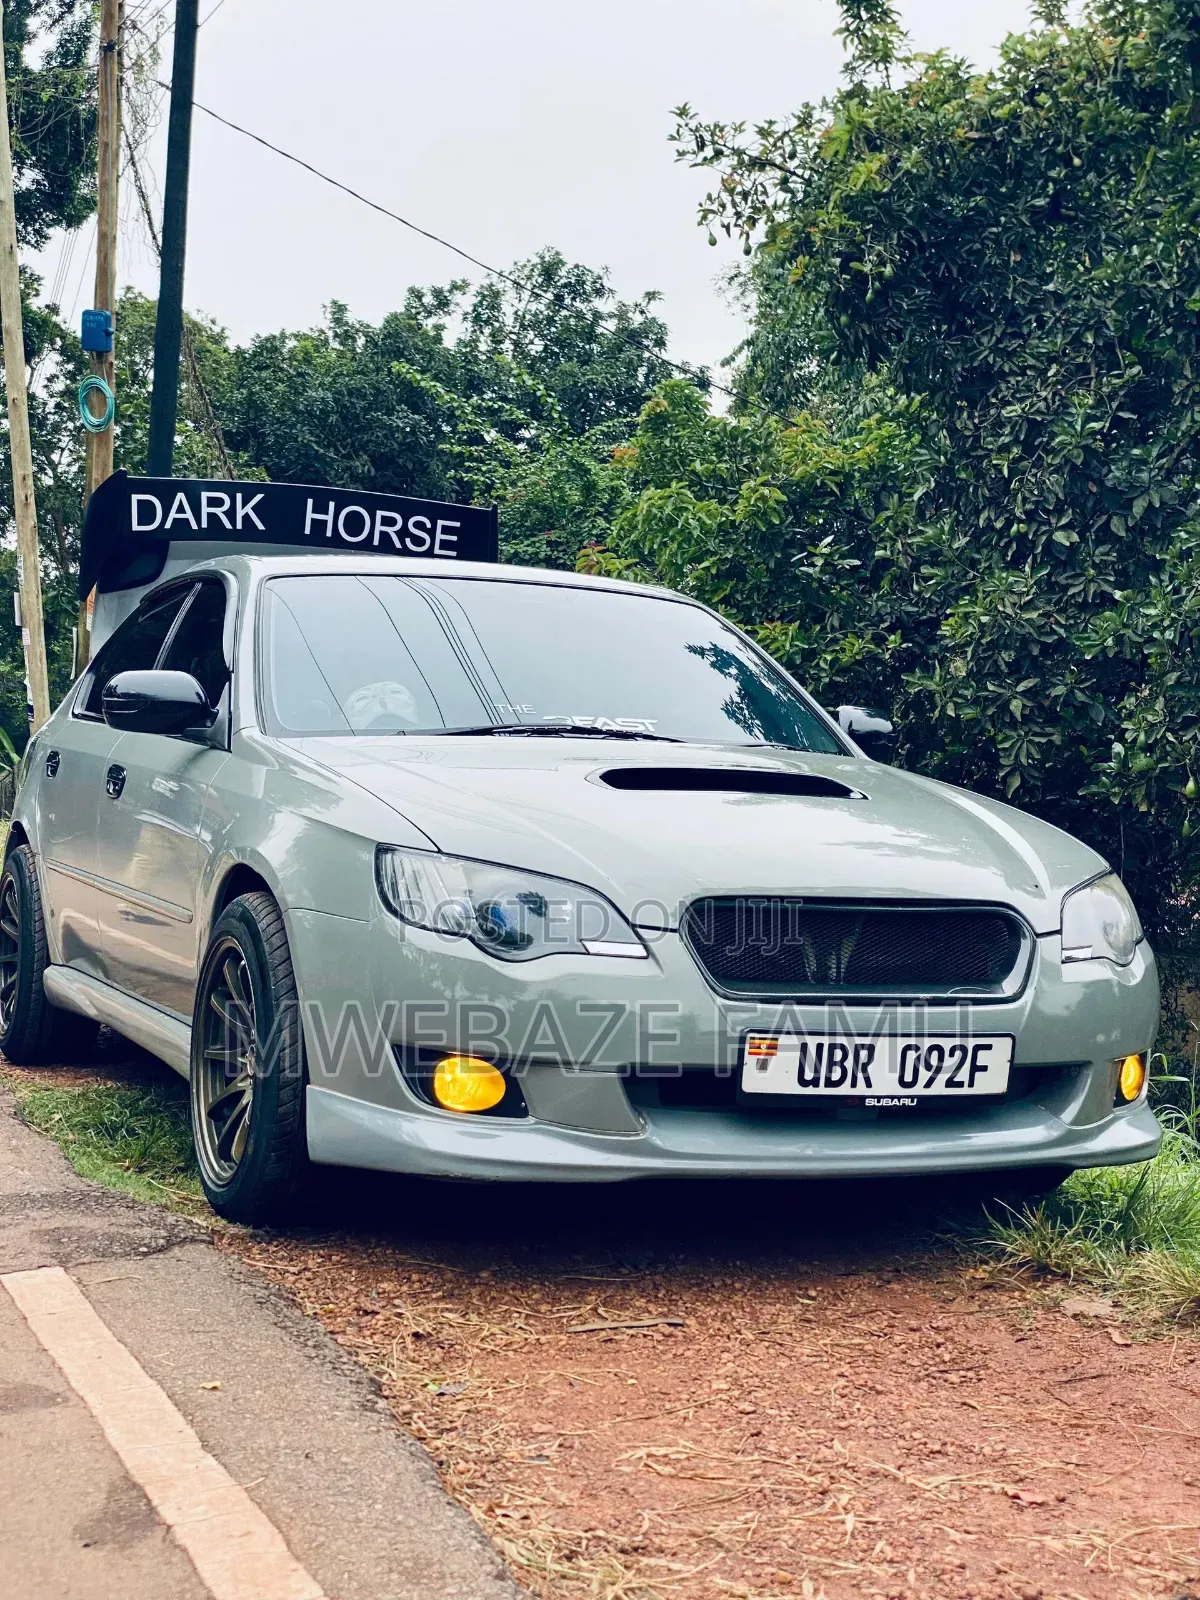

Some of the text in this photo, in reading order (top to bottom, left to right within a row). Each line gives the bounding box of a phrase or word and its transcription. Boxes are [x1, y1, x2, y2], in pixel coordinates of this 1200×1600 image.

[130, 491, 461, 557] DARK HORSE
[493, 703, 537, 715] THE
[797, 1042, 993, 1089] UBR 092F
[864, 1097, 918, 1107] SUBARU
